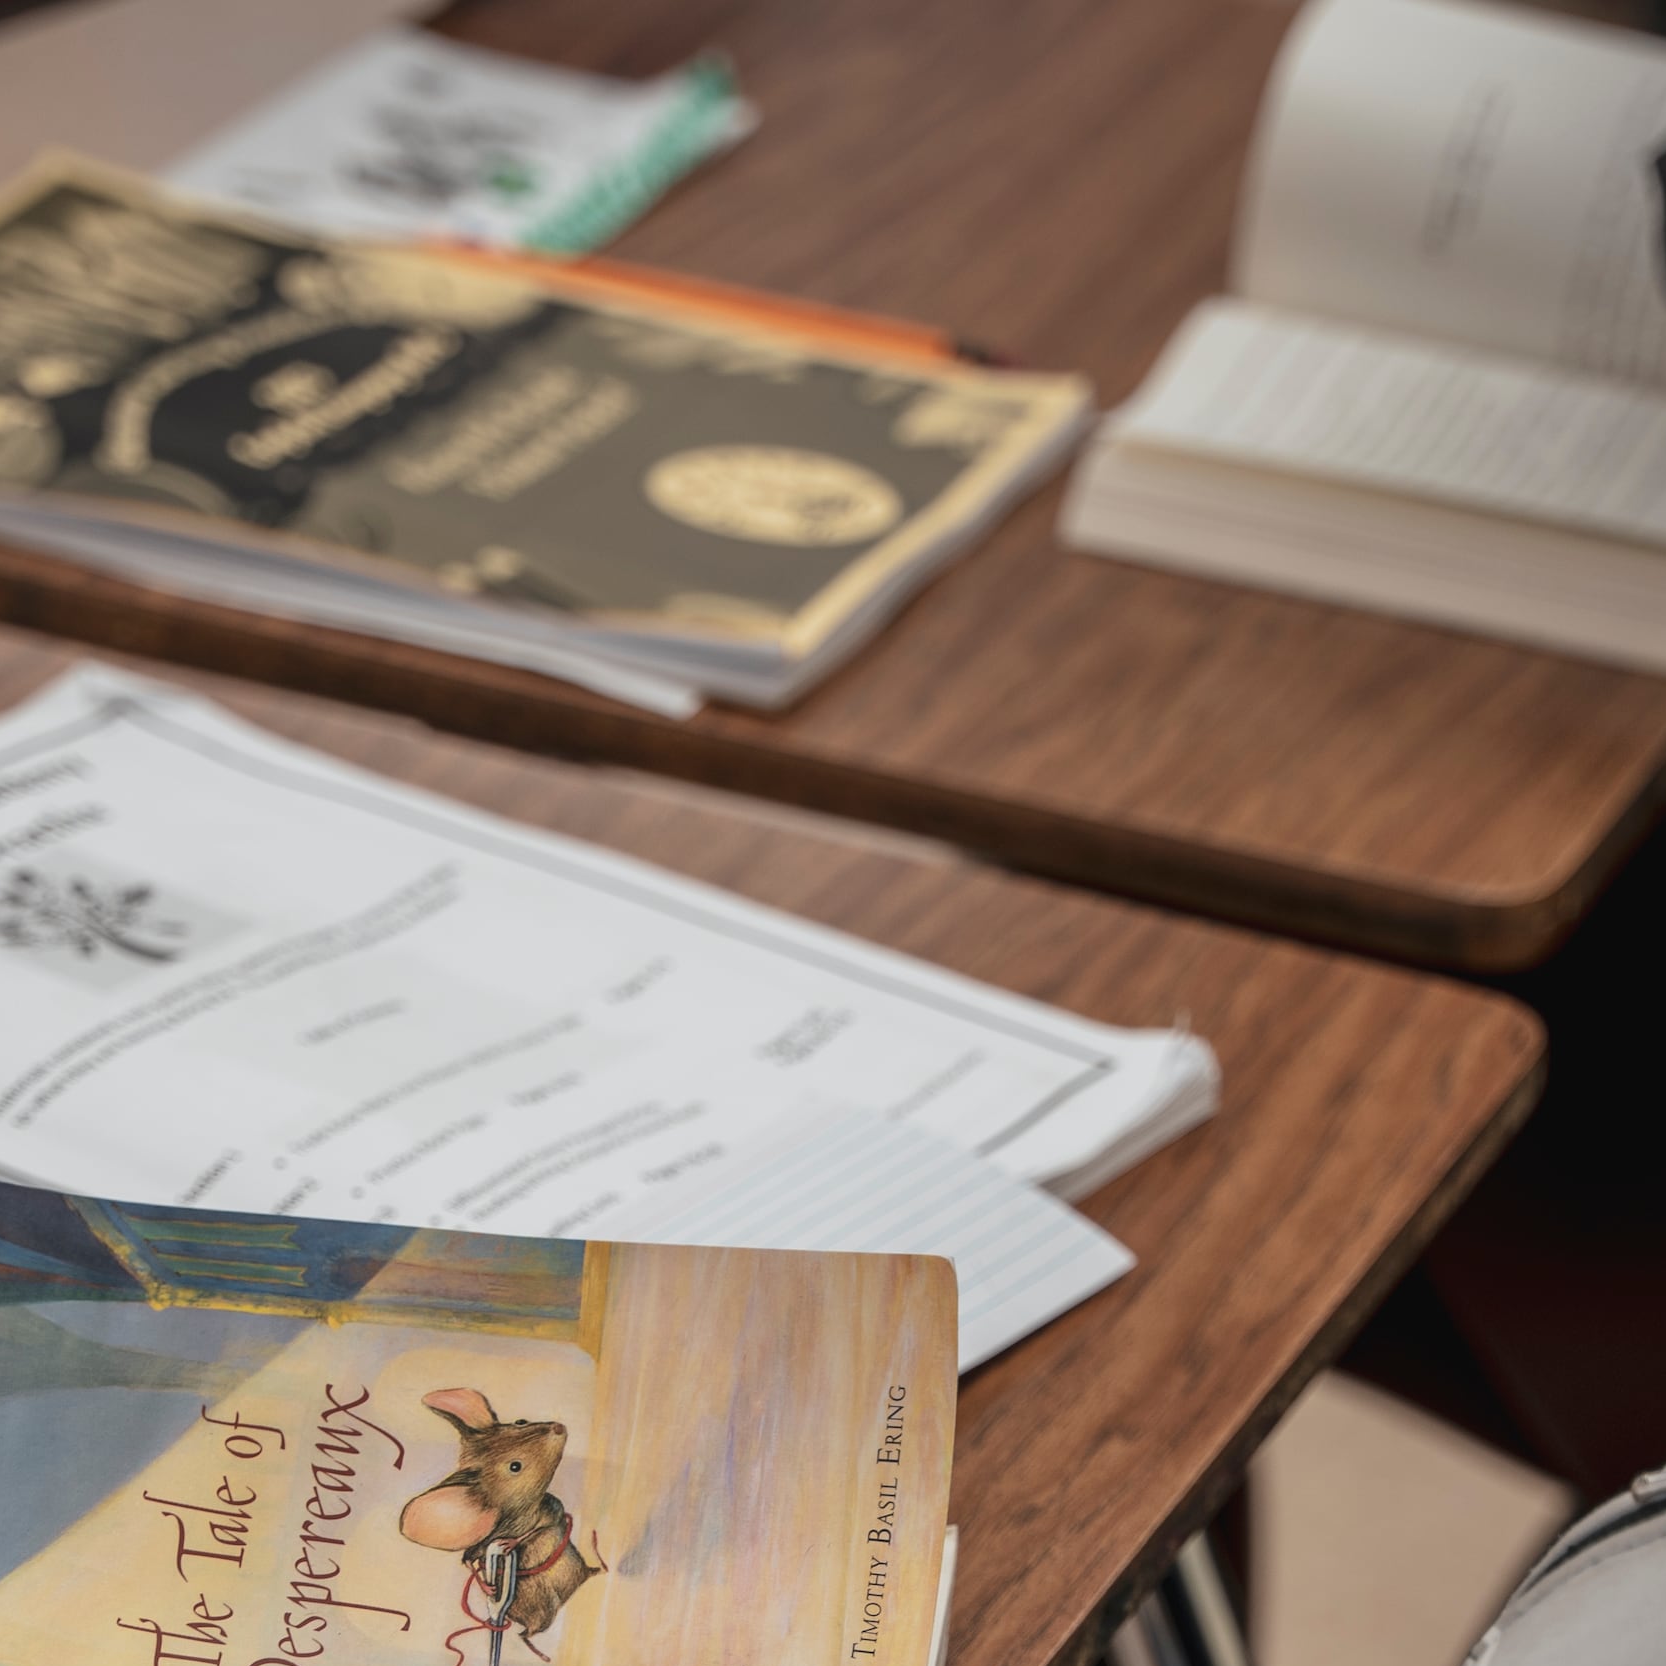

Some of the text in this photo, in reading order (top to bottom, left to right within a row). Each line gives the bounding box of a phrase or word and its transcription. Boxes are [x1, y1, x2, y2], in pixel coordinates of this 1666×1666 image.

[875, 1383, 907, 1466] ERING
[141, 1474, 258, 1584] Tale
[200, 1402, 287, 1461] of
[866, 1476, 899, 1546] BASIL
[850, 1555, 889, 1660] TIMOTHY
